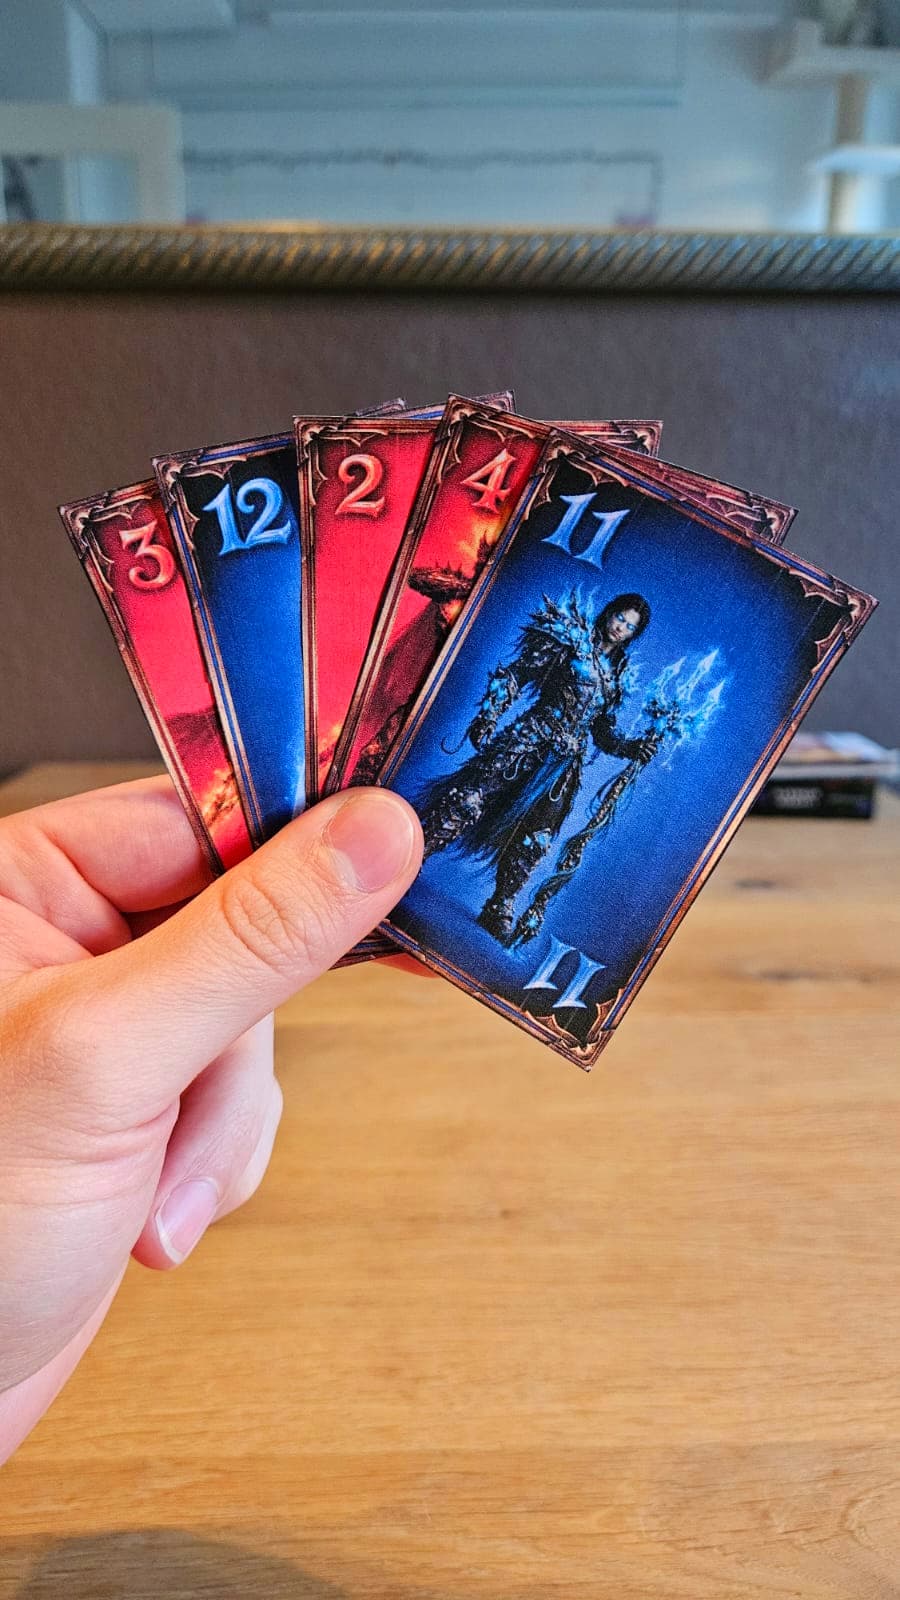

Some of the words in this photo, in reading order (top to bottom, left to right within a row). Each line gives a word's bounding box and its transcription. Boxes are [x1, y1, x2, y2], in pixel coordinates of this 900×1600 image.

[202, 478, 291, 556] 12
[335, 454, 385, 517] 2
[461, 449, 516, 514] 4
[119, 520, 175, 588] 3
[541, 492, 631, 572] 11
[523, 933, 607, 1008] 11
